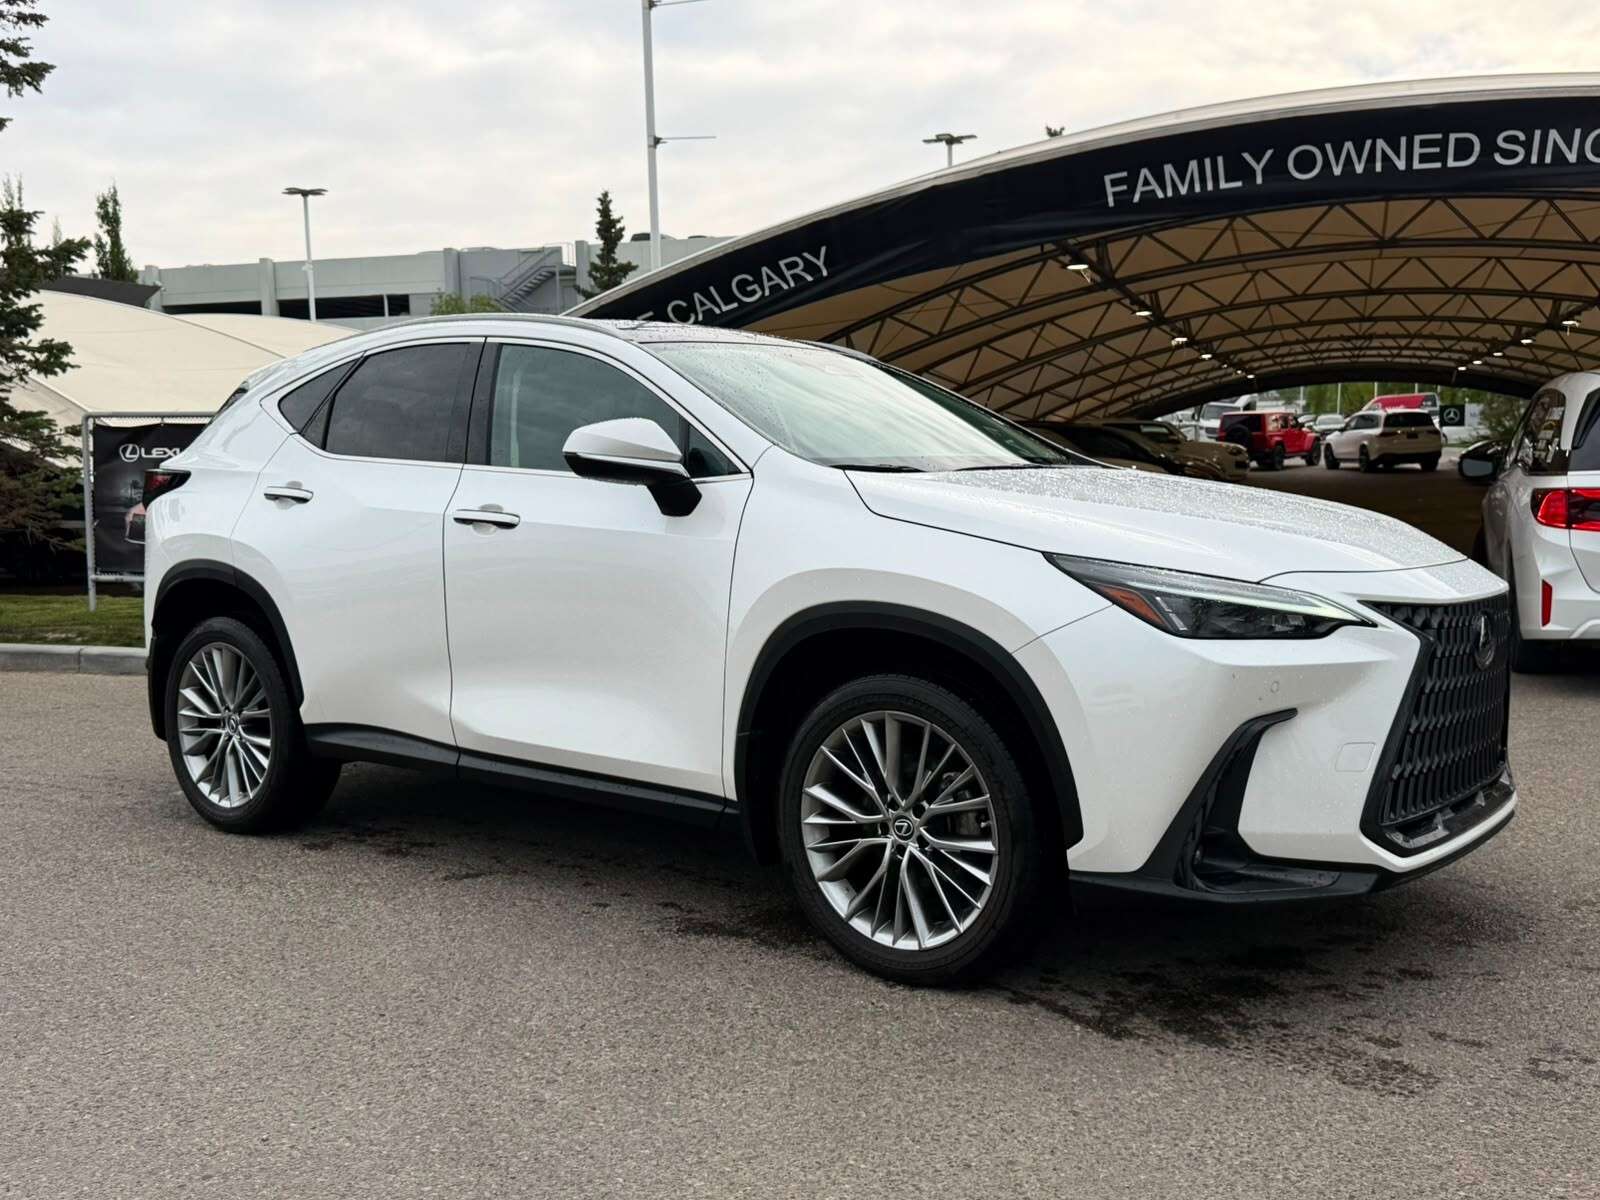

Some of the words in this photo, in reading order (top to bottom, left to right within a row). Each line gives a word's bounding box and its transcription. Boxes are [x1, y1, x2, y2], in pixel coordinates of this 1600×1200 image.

[1103, 148, 1274, 207] FAMILY
[1287, 132, 1481, 180] OWNED
[666, 246, 828, 325] CALGARY
